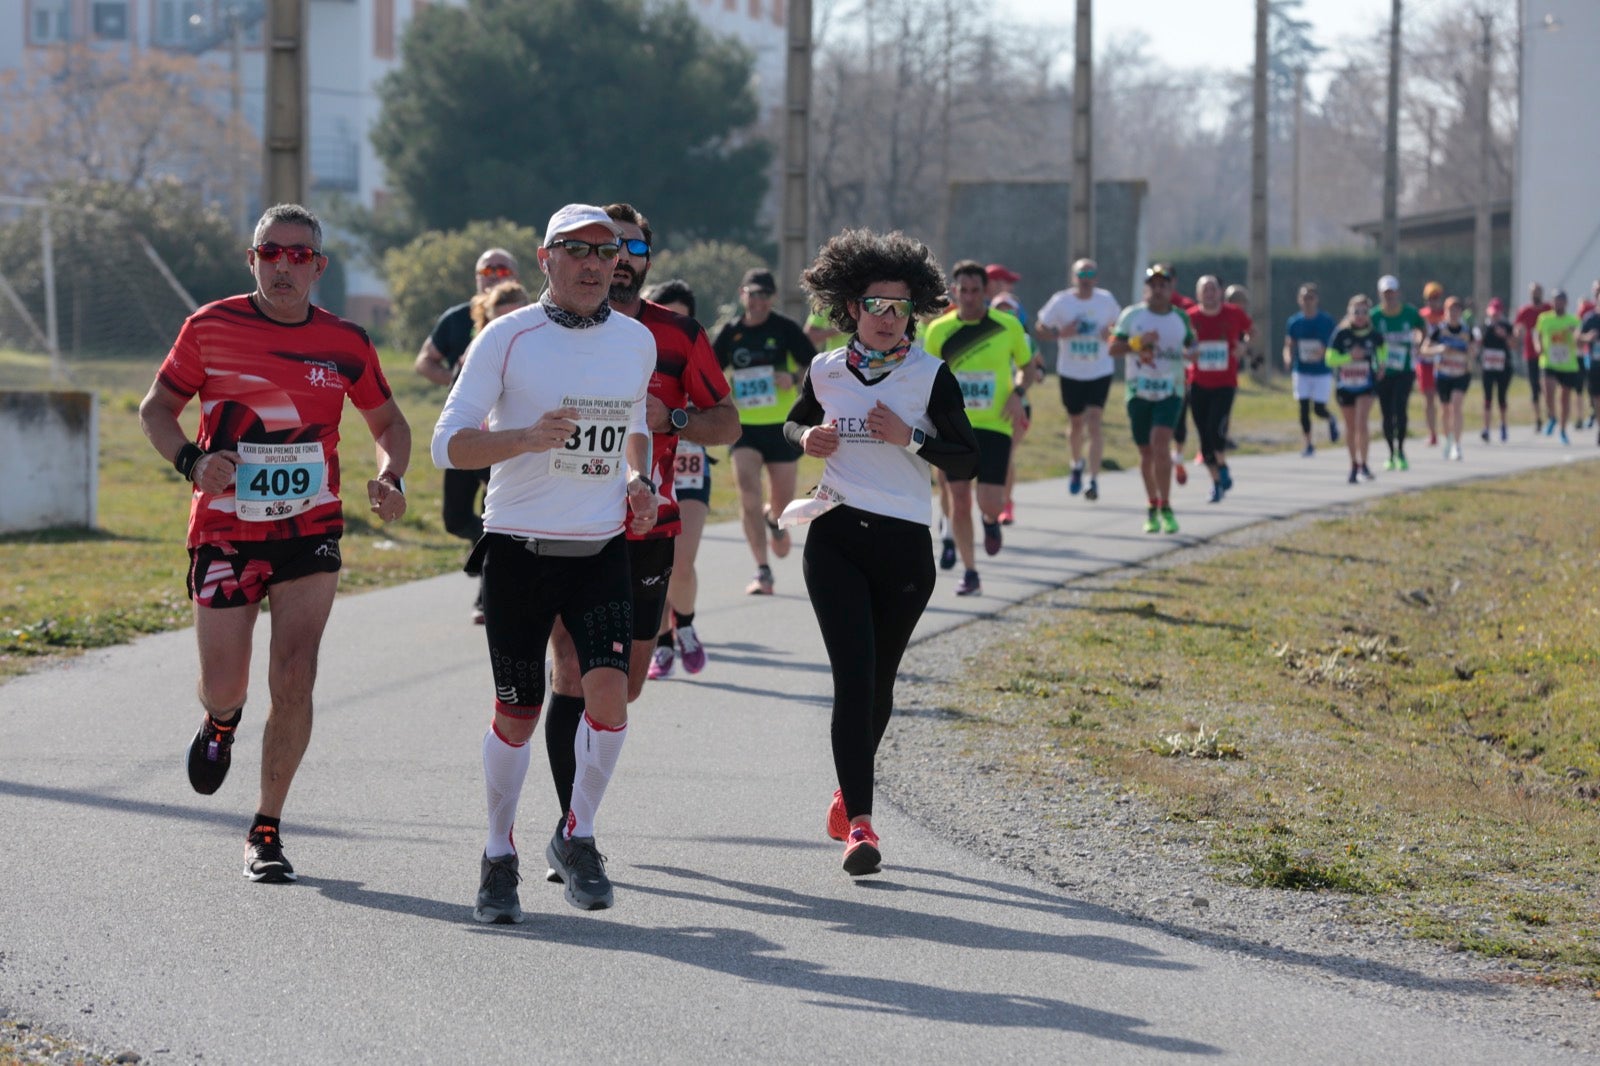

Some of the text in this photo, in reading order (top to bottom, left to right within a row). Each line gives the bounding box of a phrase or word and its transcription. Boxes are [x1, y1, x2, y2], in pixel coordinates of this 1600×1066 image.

[578, 399, 593, 407] GRAN
[593, 400, 614, 408] PREMIO
[613, 401, 620, 409] DE
[839, 417, 867, 432] TEX
[565, 425, 627, 453] 3107
[257, 446, 273, 455] GRAN
[273, 446, 294, 455] PREMIO
[294, 446, 301, 454] DE
[264, 455, 298, 463] DIPUTACIÓN
[249, 468, 310, 496] 409
